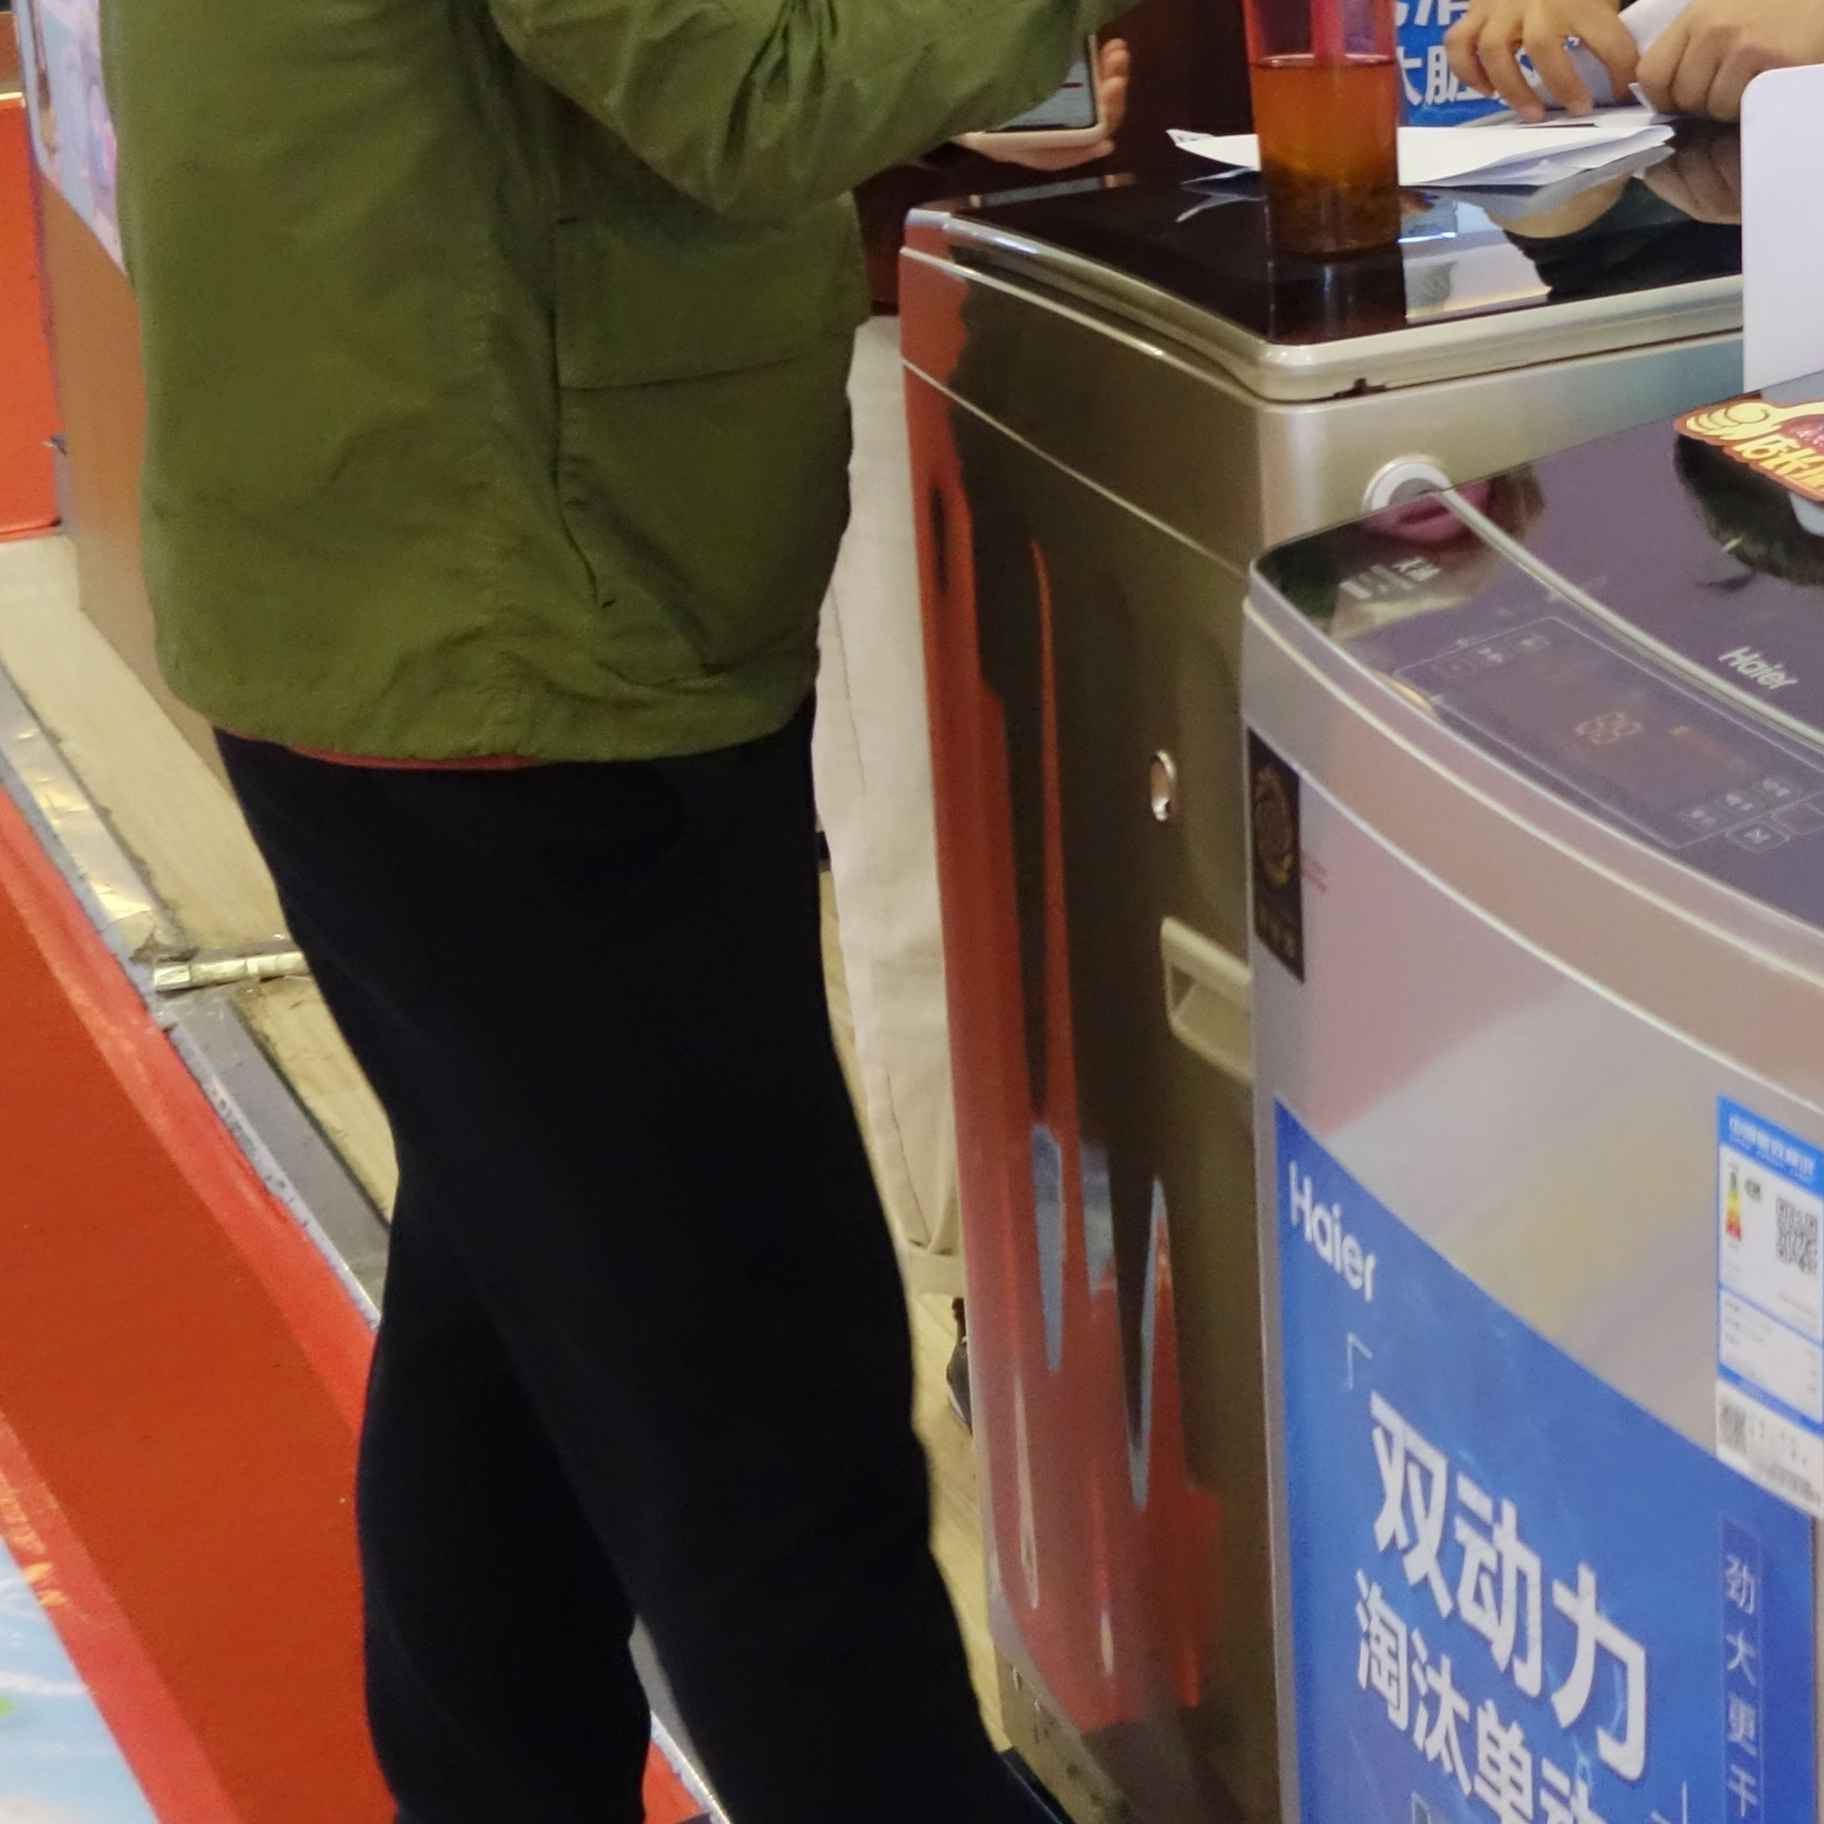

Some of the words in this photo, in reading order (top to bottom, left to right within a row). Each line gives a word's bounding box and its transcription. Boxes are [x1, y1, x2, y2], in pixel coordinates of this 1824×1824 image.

[1718, 645, 1799, 691] Haier
[1288, 1161, 1377, 1301] Haier
[1368, 1389, 1648, 1782] 双动力
